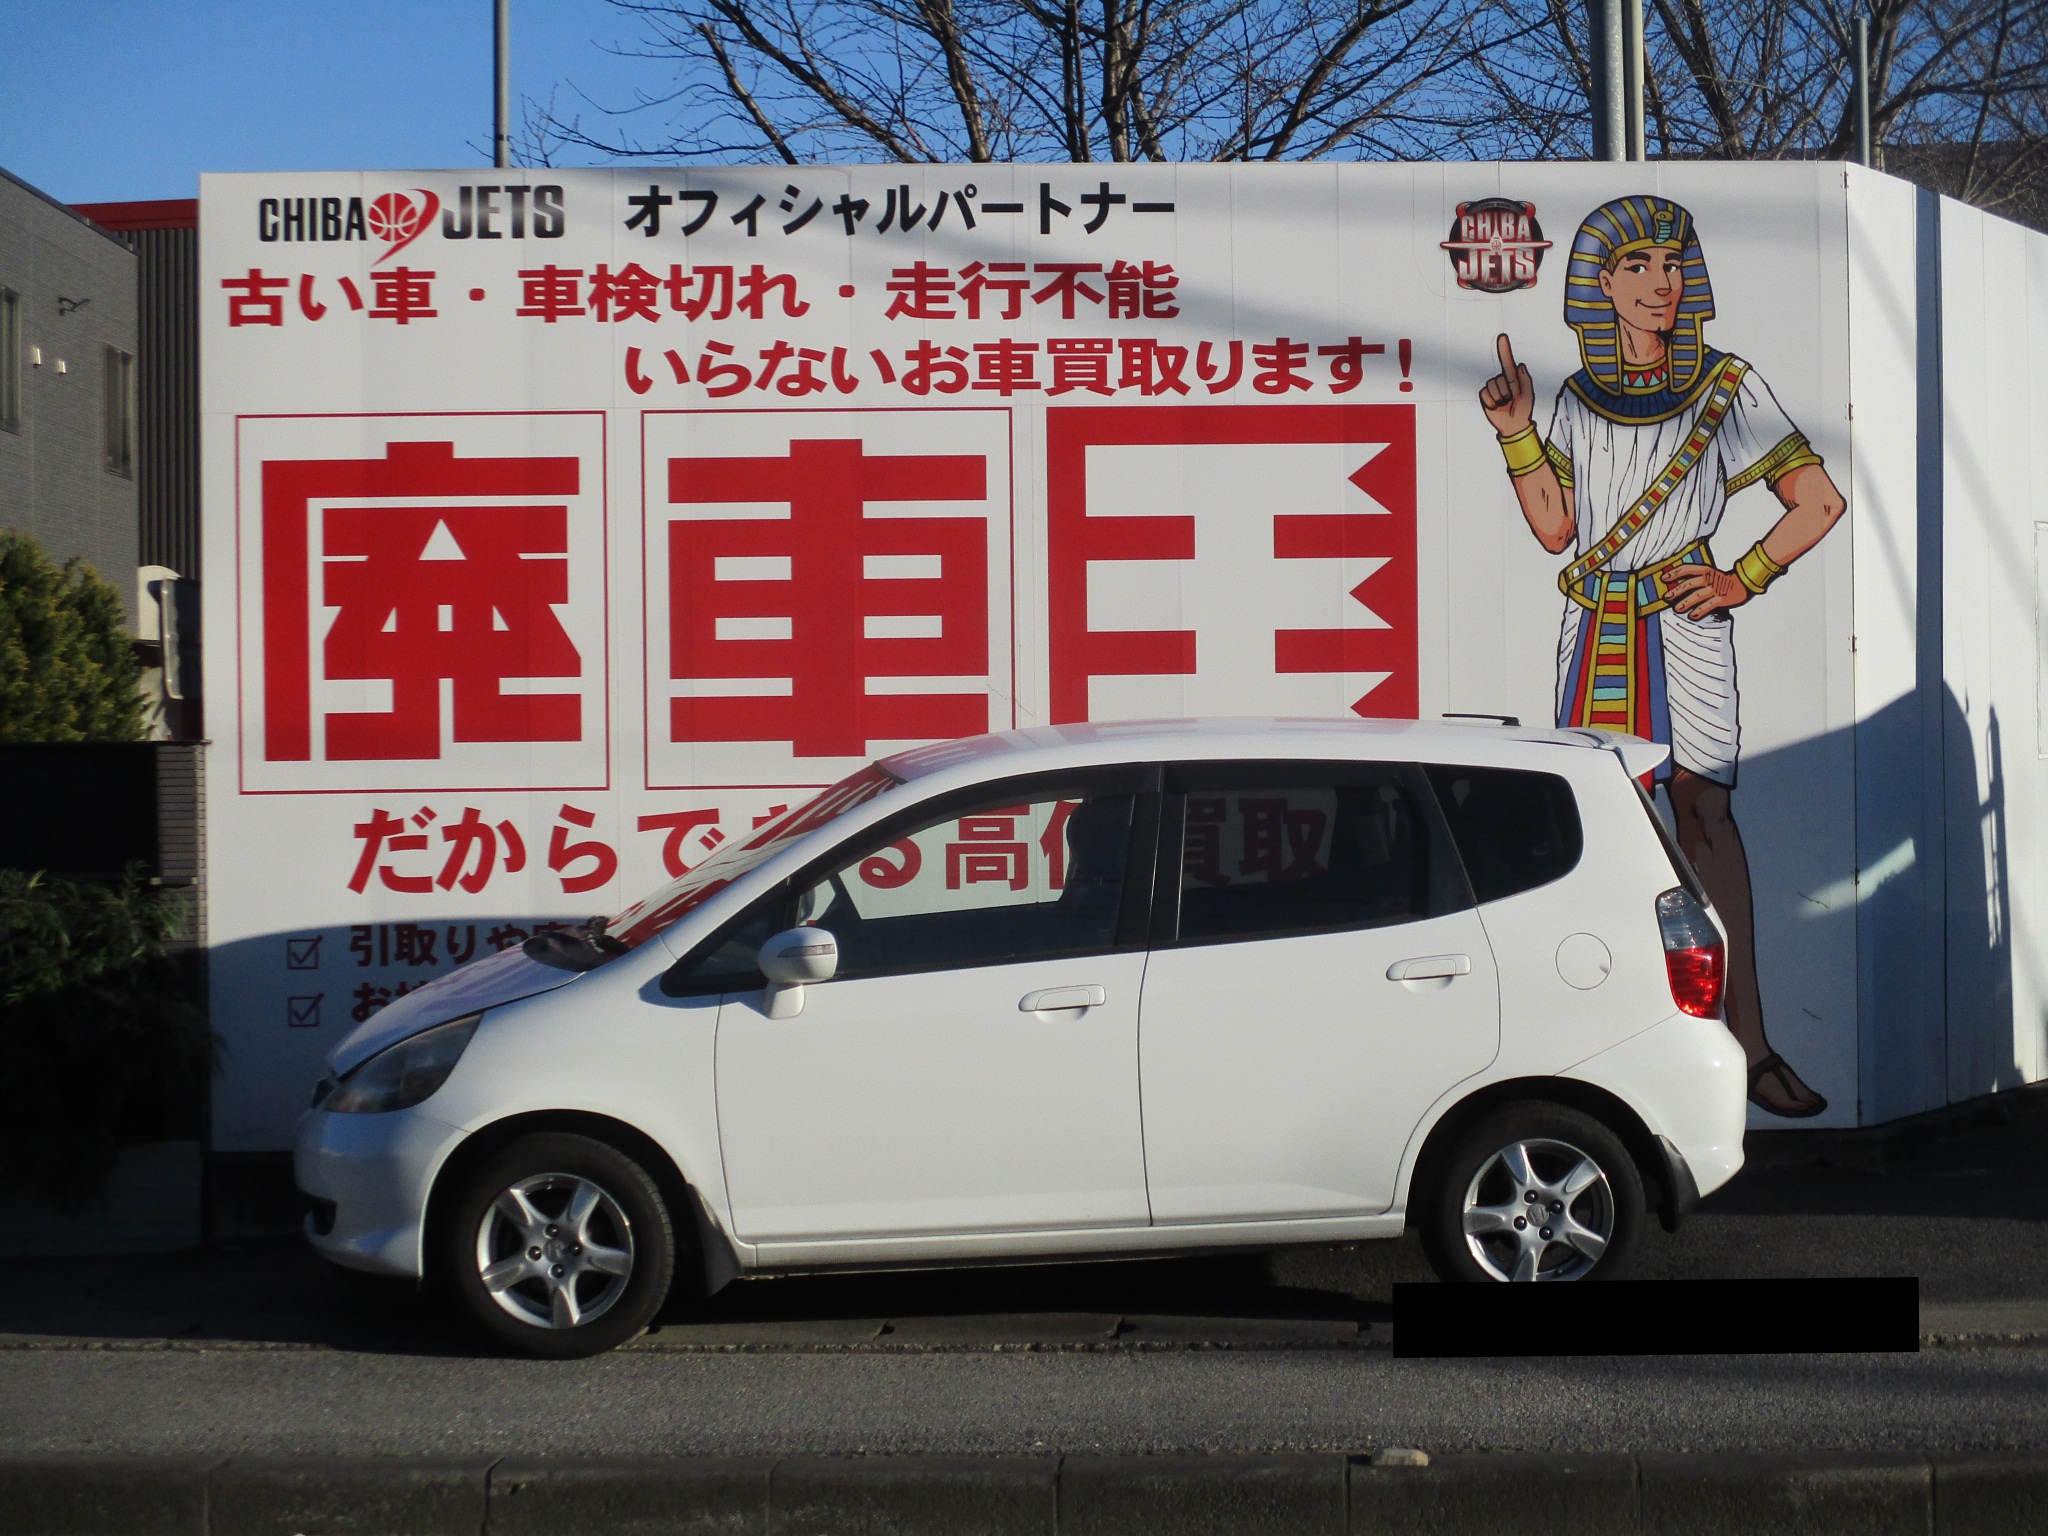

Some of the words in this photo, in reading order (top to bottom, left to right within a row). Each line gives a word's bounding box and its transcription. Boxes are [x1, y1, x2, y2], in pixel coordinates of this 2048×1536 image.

[259, 197, 366, 242] CHIBA
[442, 184, 565, 240] JETS
[624, 182, 1175, 237] オフィシャルパートナー
[1461, 211, 1532, 242] CHIBA
[1458, 247, 1535, 284] JETS
[624, 336, 1413, 399] いらないお車買取ります！
